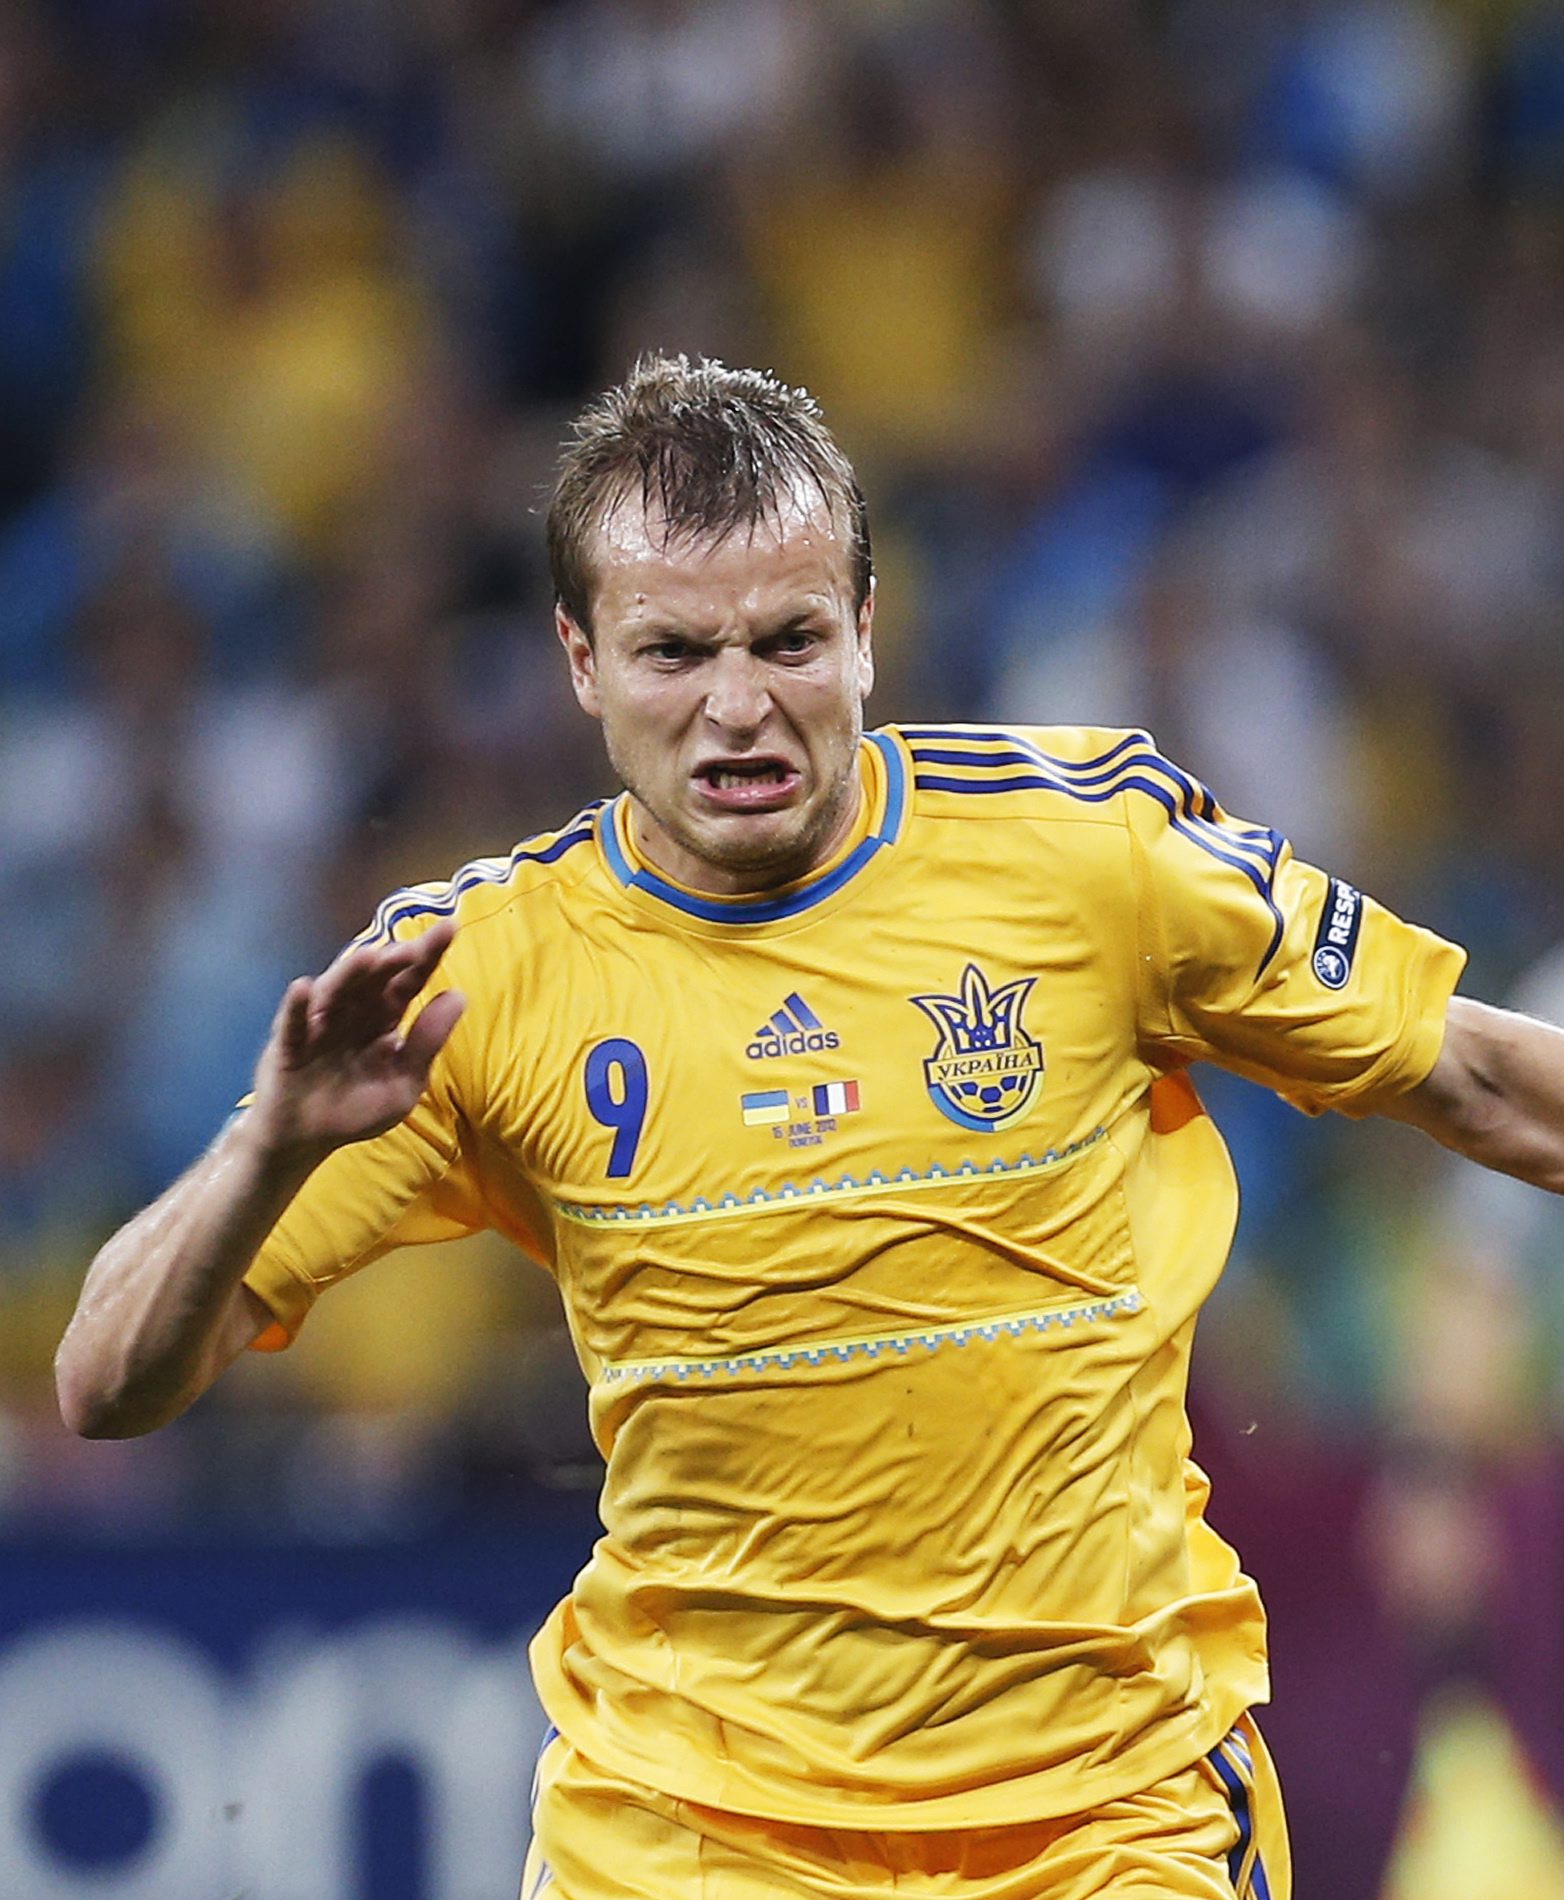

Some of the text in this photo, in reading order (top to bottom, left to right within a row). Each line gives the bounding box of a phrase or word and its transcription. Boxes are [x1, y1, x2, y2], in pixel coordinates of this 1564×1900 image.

[1328, 879, 1360, 945] RESP
[745, 1031, 839, 1060] adidas
[937, 1051, 1034, 1081] УКРАЇНА
[584, 1037, 649, 1179] 9
